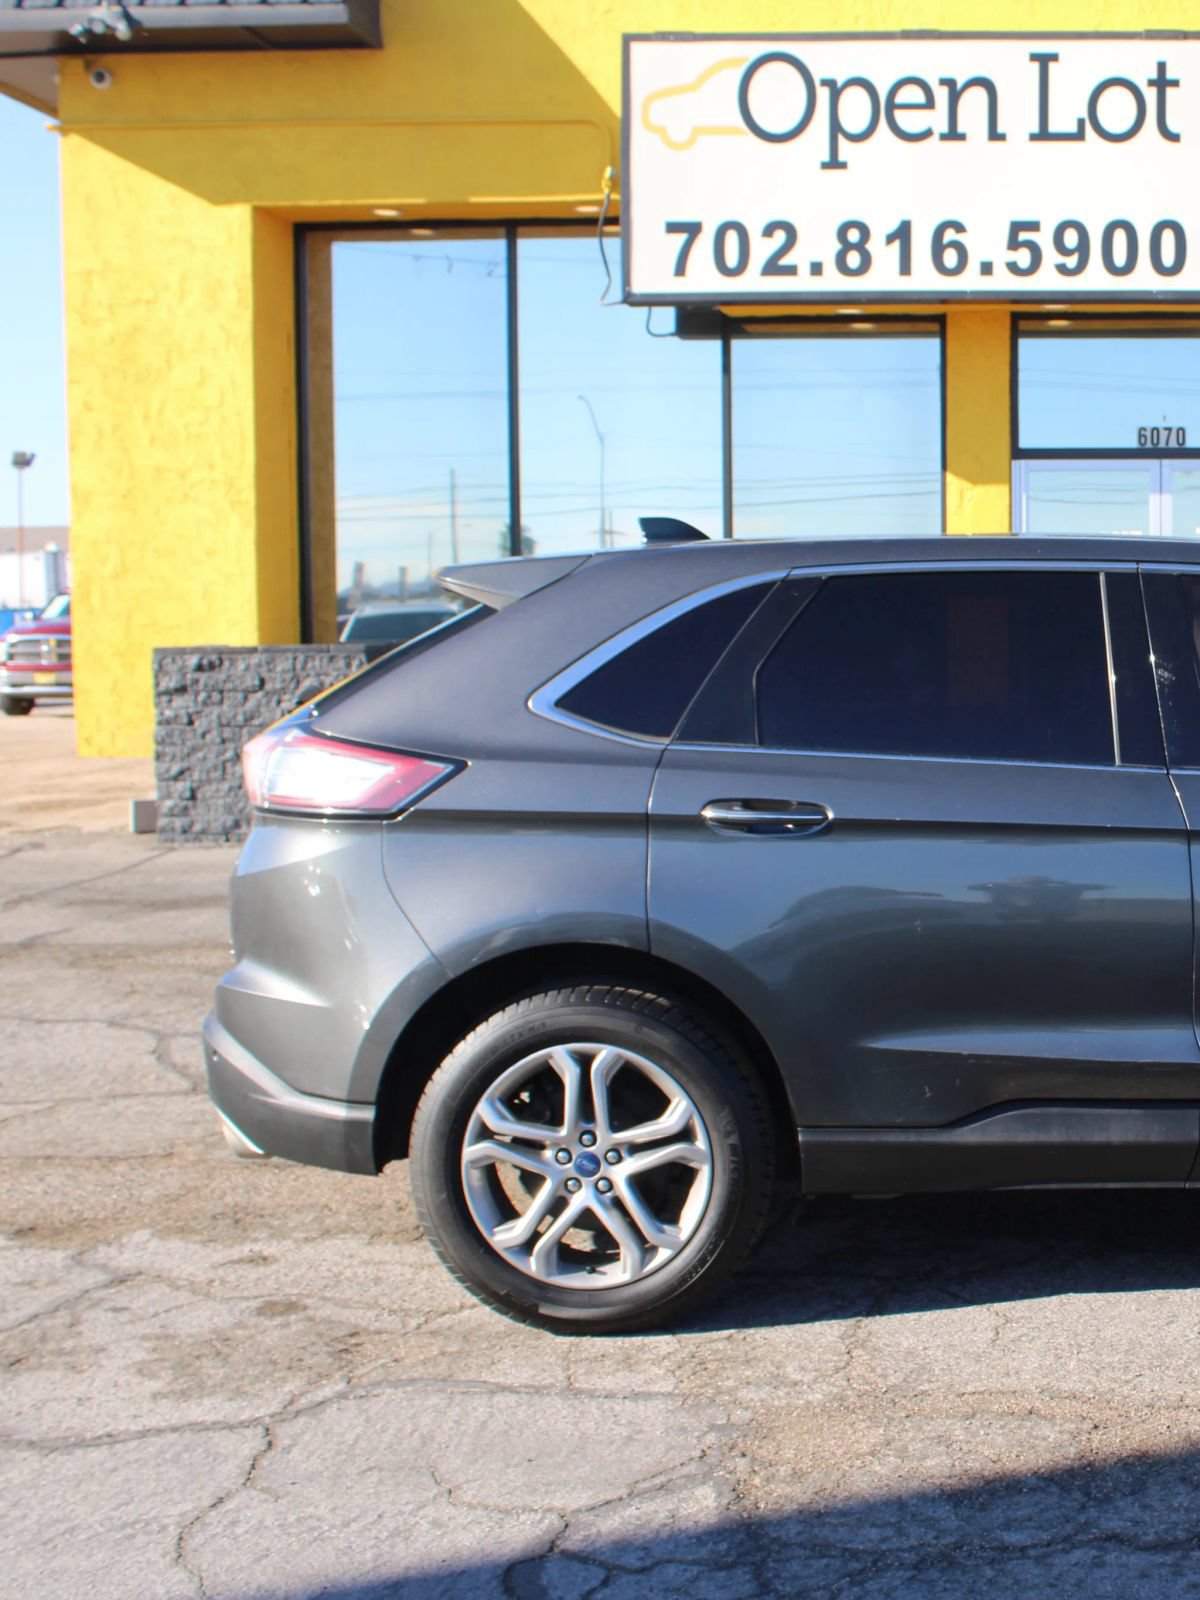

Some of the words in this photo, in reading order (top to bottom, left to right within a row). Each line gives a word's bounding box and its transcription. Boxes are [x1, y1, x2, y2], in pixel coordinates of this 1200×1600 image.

[738, 51, 1007, 170] Open
[1028, 52, 1181, 144] Lot
[665, 219, 1188, 278] 702.816.5900
[1138, 426, 1187, 447] 6070
